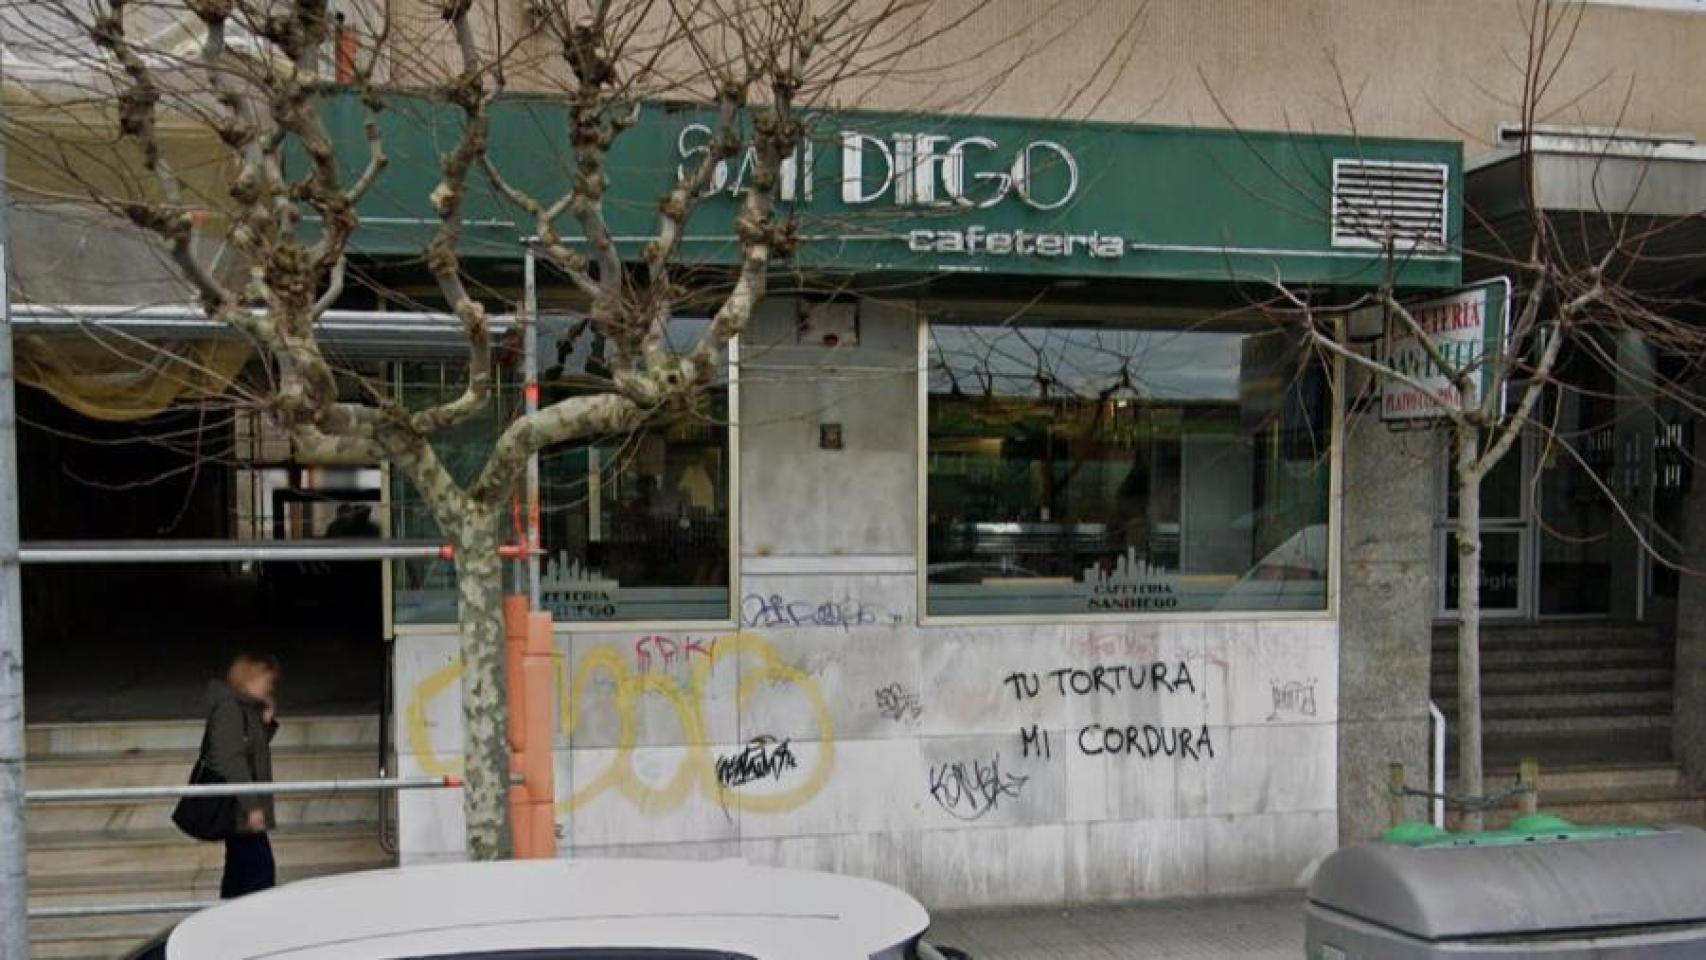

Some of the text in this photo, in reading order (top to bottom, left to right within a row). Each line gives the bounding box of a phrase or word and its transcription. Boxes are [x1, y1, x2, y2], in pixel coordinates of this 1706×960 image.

[842, 131, 1078, 210] DIEGO
[909, 225, 1123, 257] cafeteria
[1004, 661, 1195, 700] TU TORTURA
[1021, 722, 1214, 761] MI CORDURA
